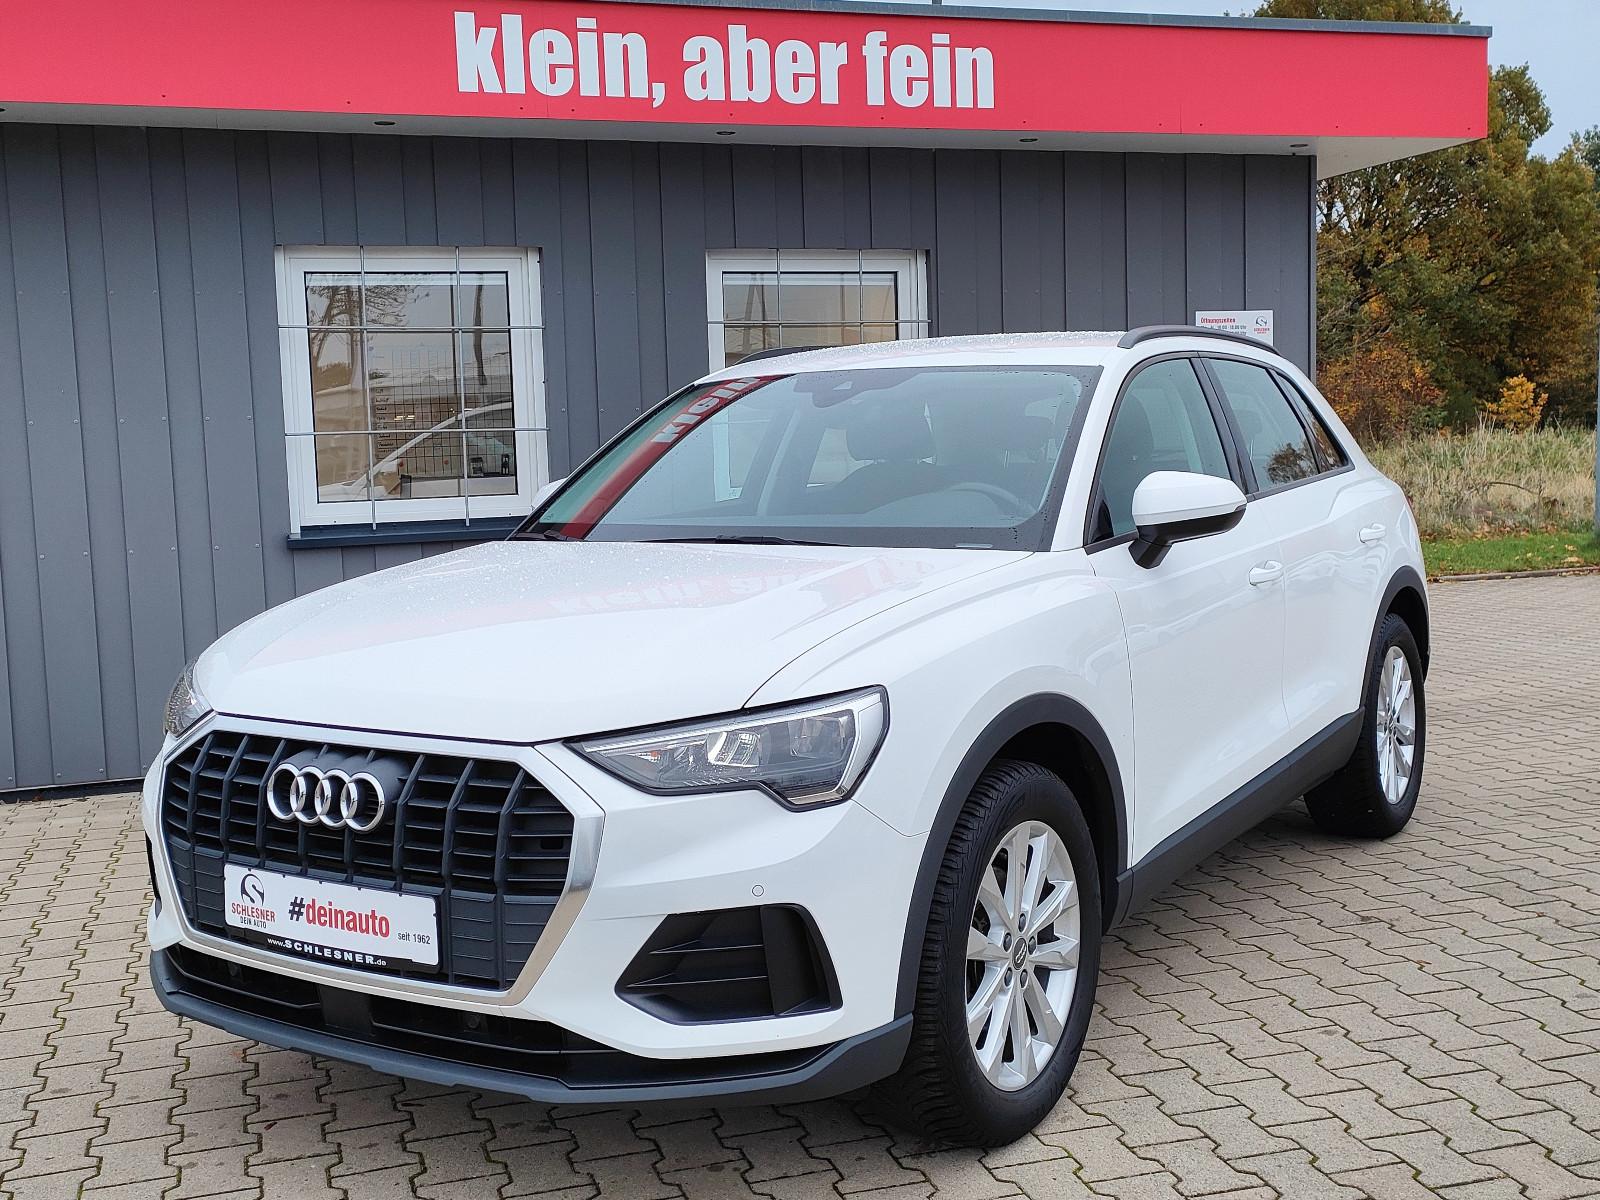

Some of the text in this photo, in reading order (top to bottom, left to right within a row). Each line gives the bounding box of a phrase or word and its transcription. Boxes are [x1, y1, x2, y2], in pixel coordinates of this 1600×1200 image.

[454, 11, 994, 109] klein, aber fein
[231, 902, 276, 923] SCHLESNER
[253, 919, 267, 929] AUTO
[288, 896, 390, 938] #deinauto
[397, 931, 431, 945] seit 1962
[266, 937, 387, 966] www.SCHLESNER.de
